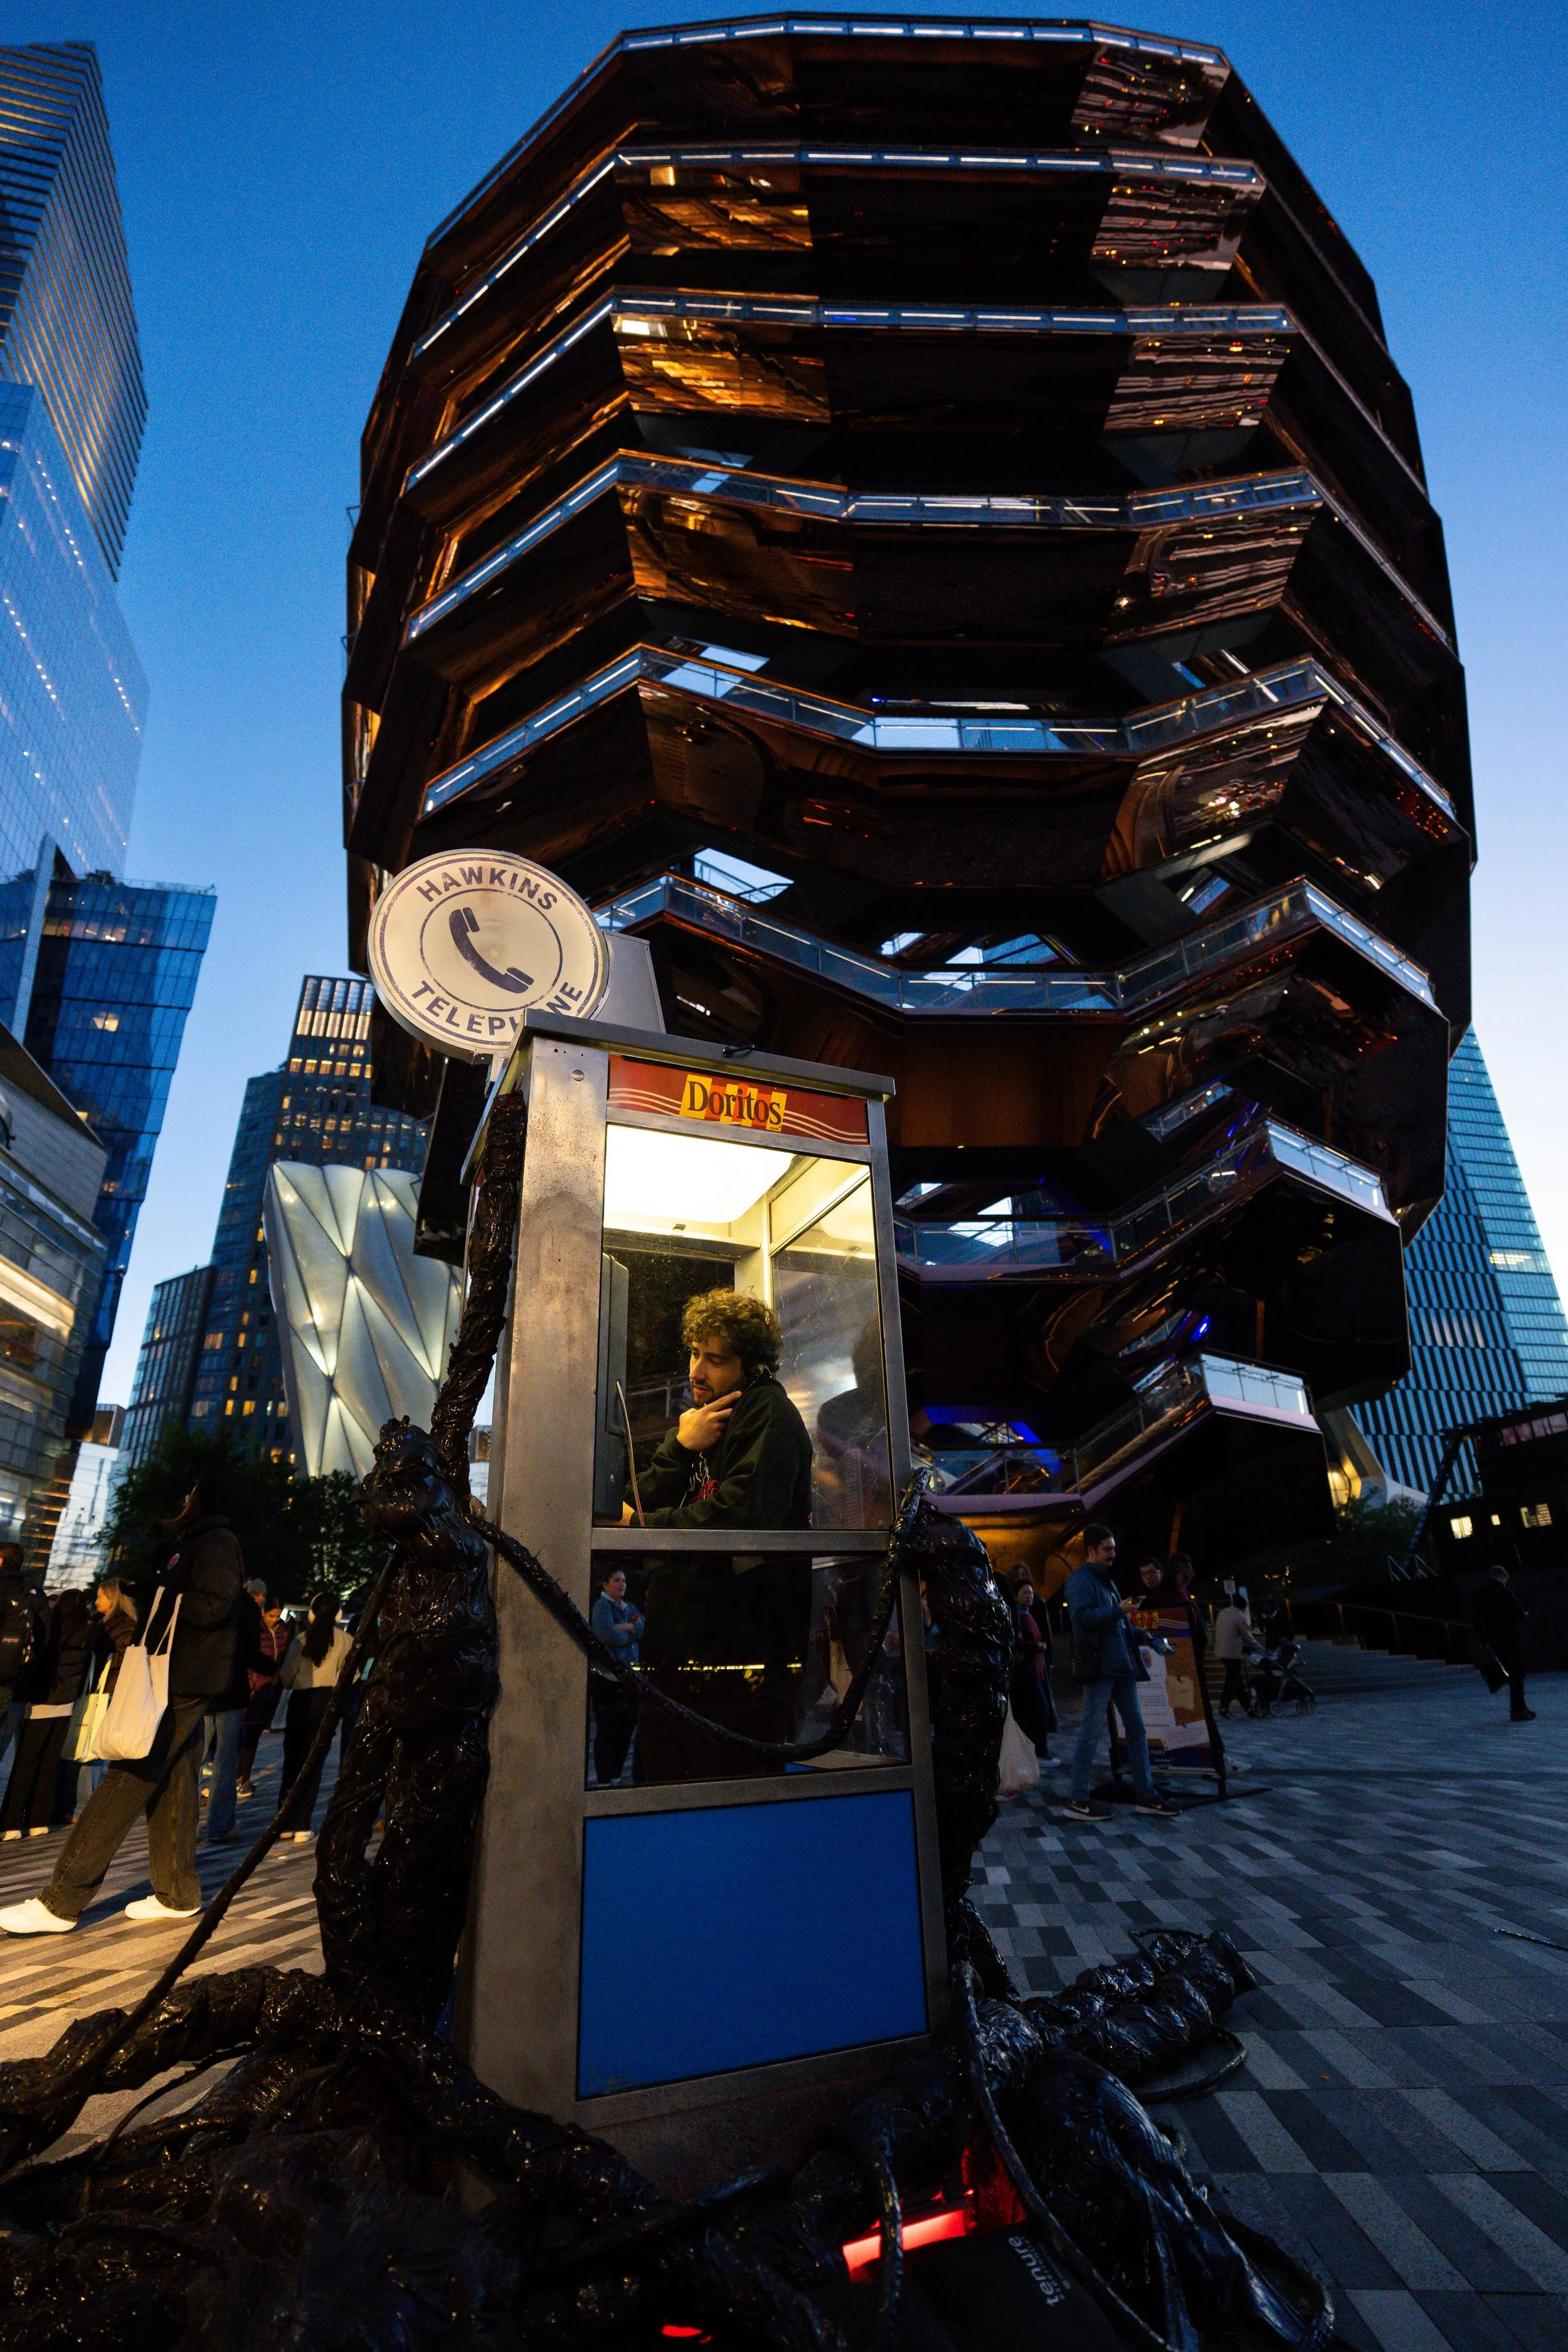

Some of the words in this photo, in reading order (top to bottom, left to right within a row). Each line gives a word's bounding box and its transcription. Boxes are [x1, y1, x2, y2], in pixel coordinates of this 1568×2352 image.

[416, 866, 558, 910] HAWKINS
[411, 981, 583, 1036] TELEPNE
[687, 1080, 782, 1126] Doritos
